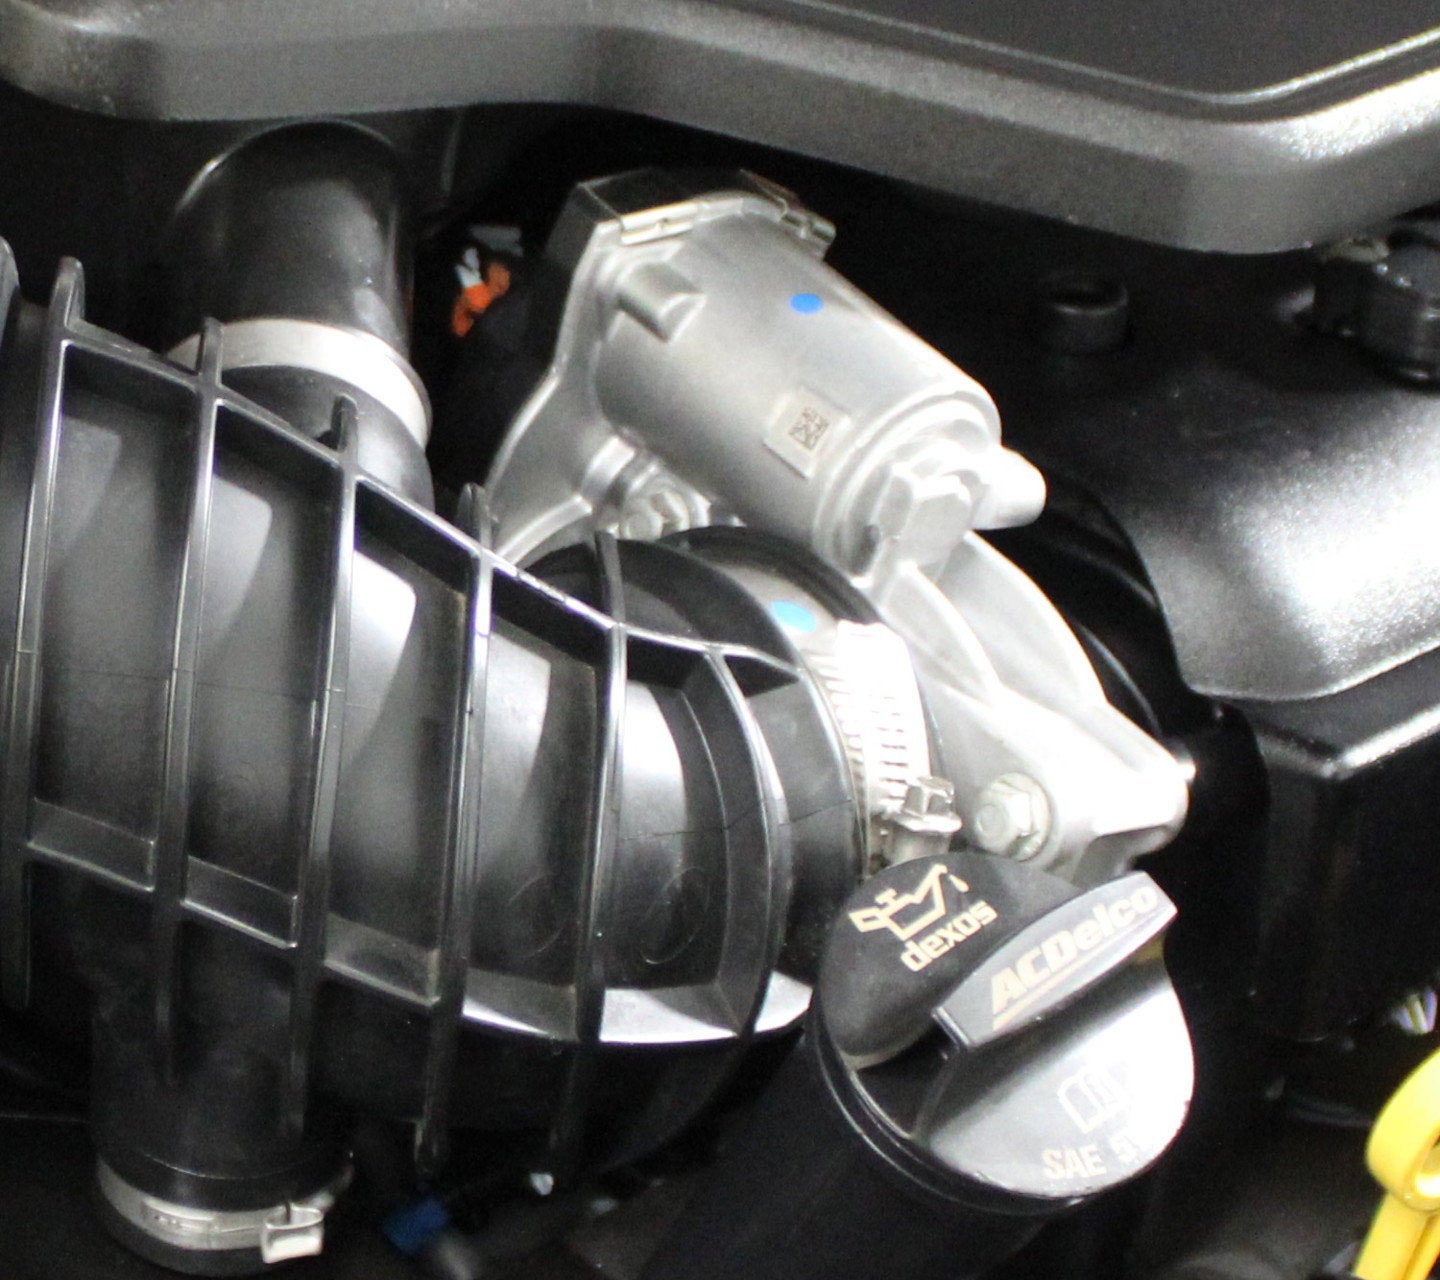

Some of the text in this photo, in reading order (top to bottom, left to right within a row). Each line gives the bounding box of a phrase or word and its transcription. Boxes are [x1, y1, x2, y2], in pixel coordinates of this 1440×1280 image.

[901, 900, 998, 972] dexos
[993, 885, 1159, 1013] ACDelco
[1042, 1144, 1108, 1180] SAE
